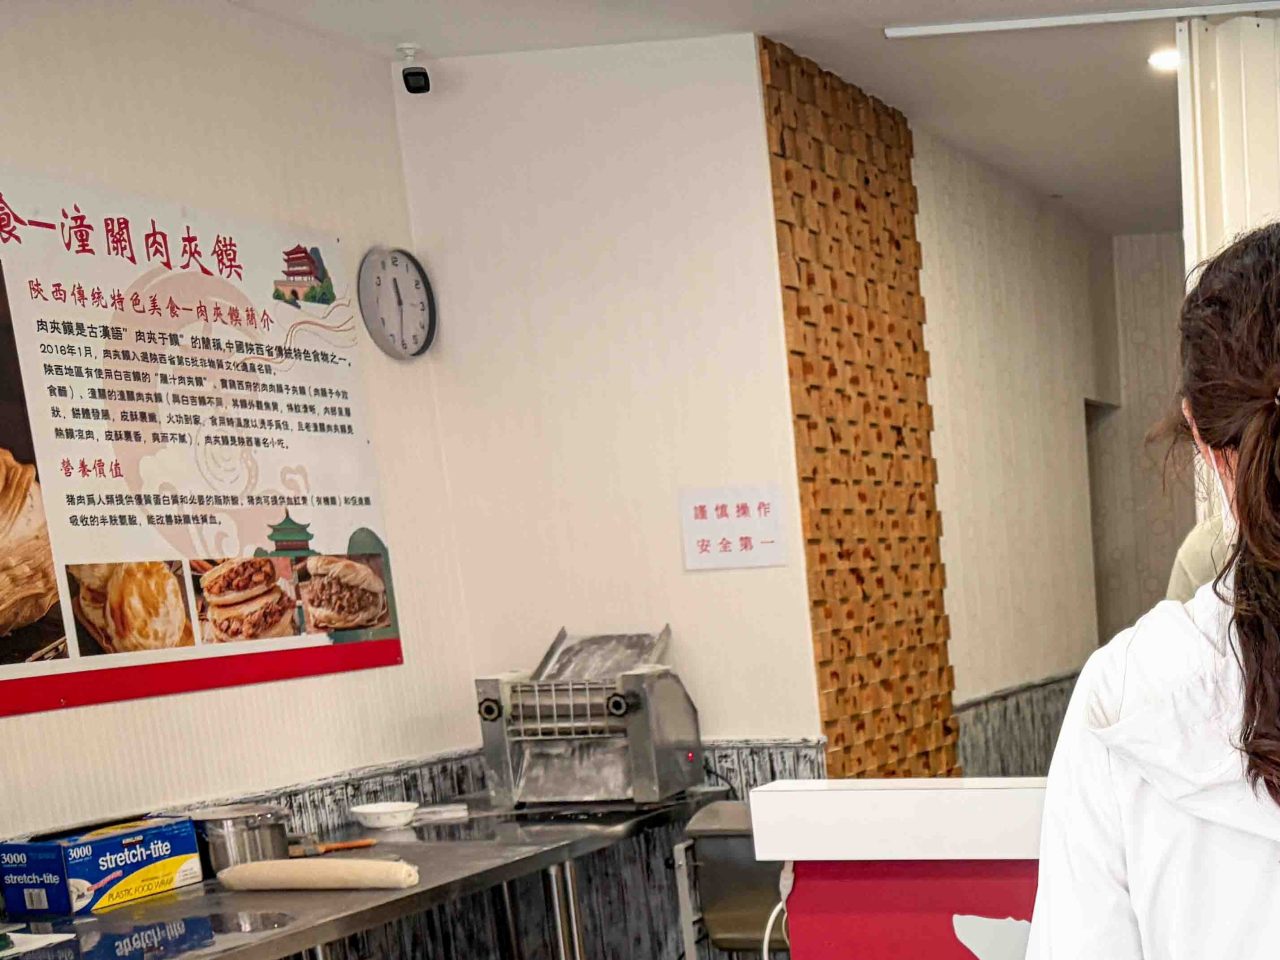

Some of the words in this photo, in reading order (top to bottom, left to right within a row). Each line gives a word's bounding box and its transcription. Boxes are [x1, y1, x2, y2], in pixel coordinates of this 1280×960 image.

[60, 457, 124, 479] 營養價值
[693, 501, 771, 520] 謹慎操作
[696, 536, 775, 554] 安全第一
[0, 852, 28, 865] 3000
[68, 844, 93, 861] 3000
[98, 840, 172, 871] stretch-tite
[4, 872, 60, 886] stretch-tite
